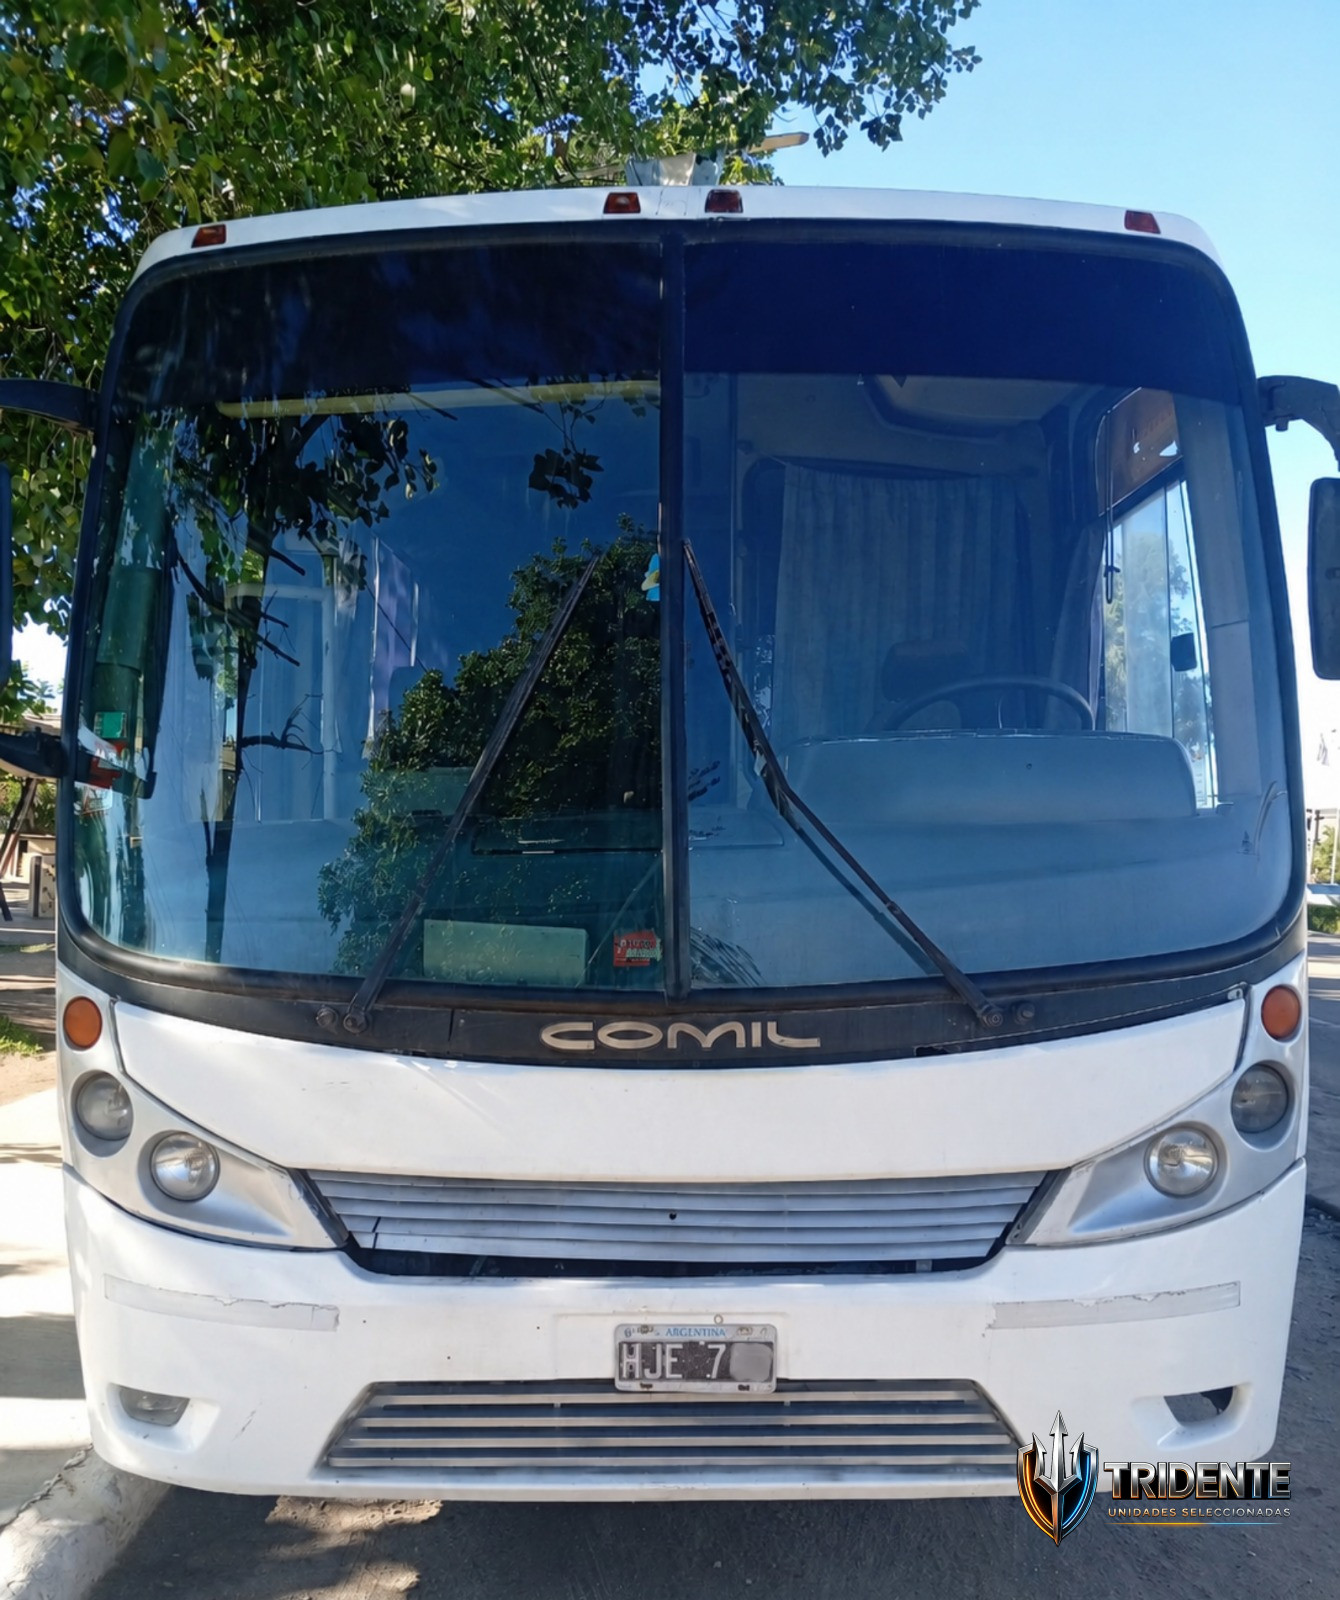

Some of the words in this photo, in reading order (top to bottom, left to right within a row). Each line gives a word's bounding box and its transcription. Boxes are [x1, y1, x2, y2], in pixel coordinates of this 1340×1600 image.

[541, 1021, 821, 1050] COMIL
[665, 1327, 727, 1337] ARGENTINA
[622, 1343, 684, 1379] HJE
